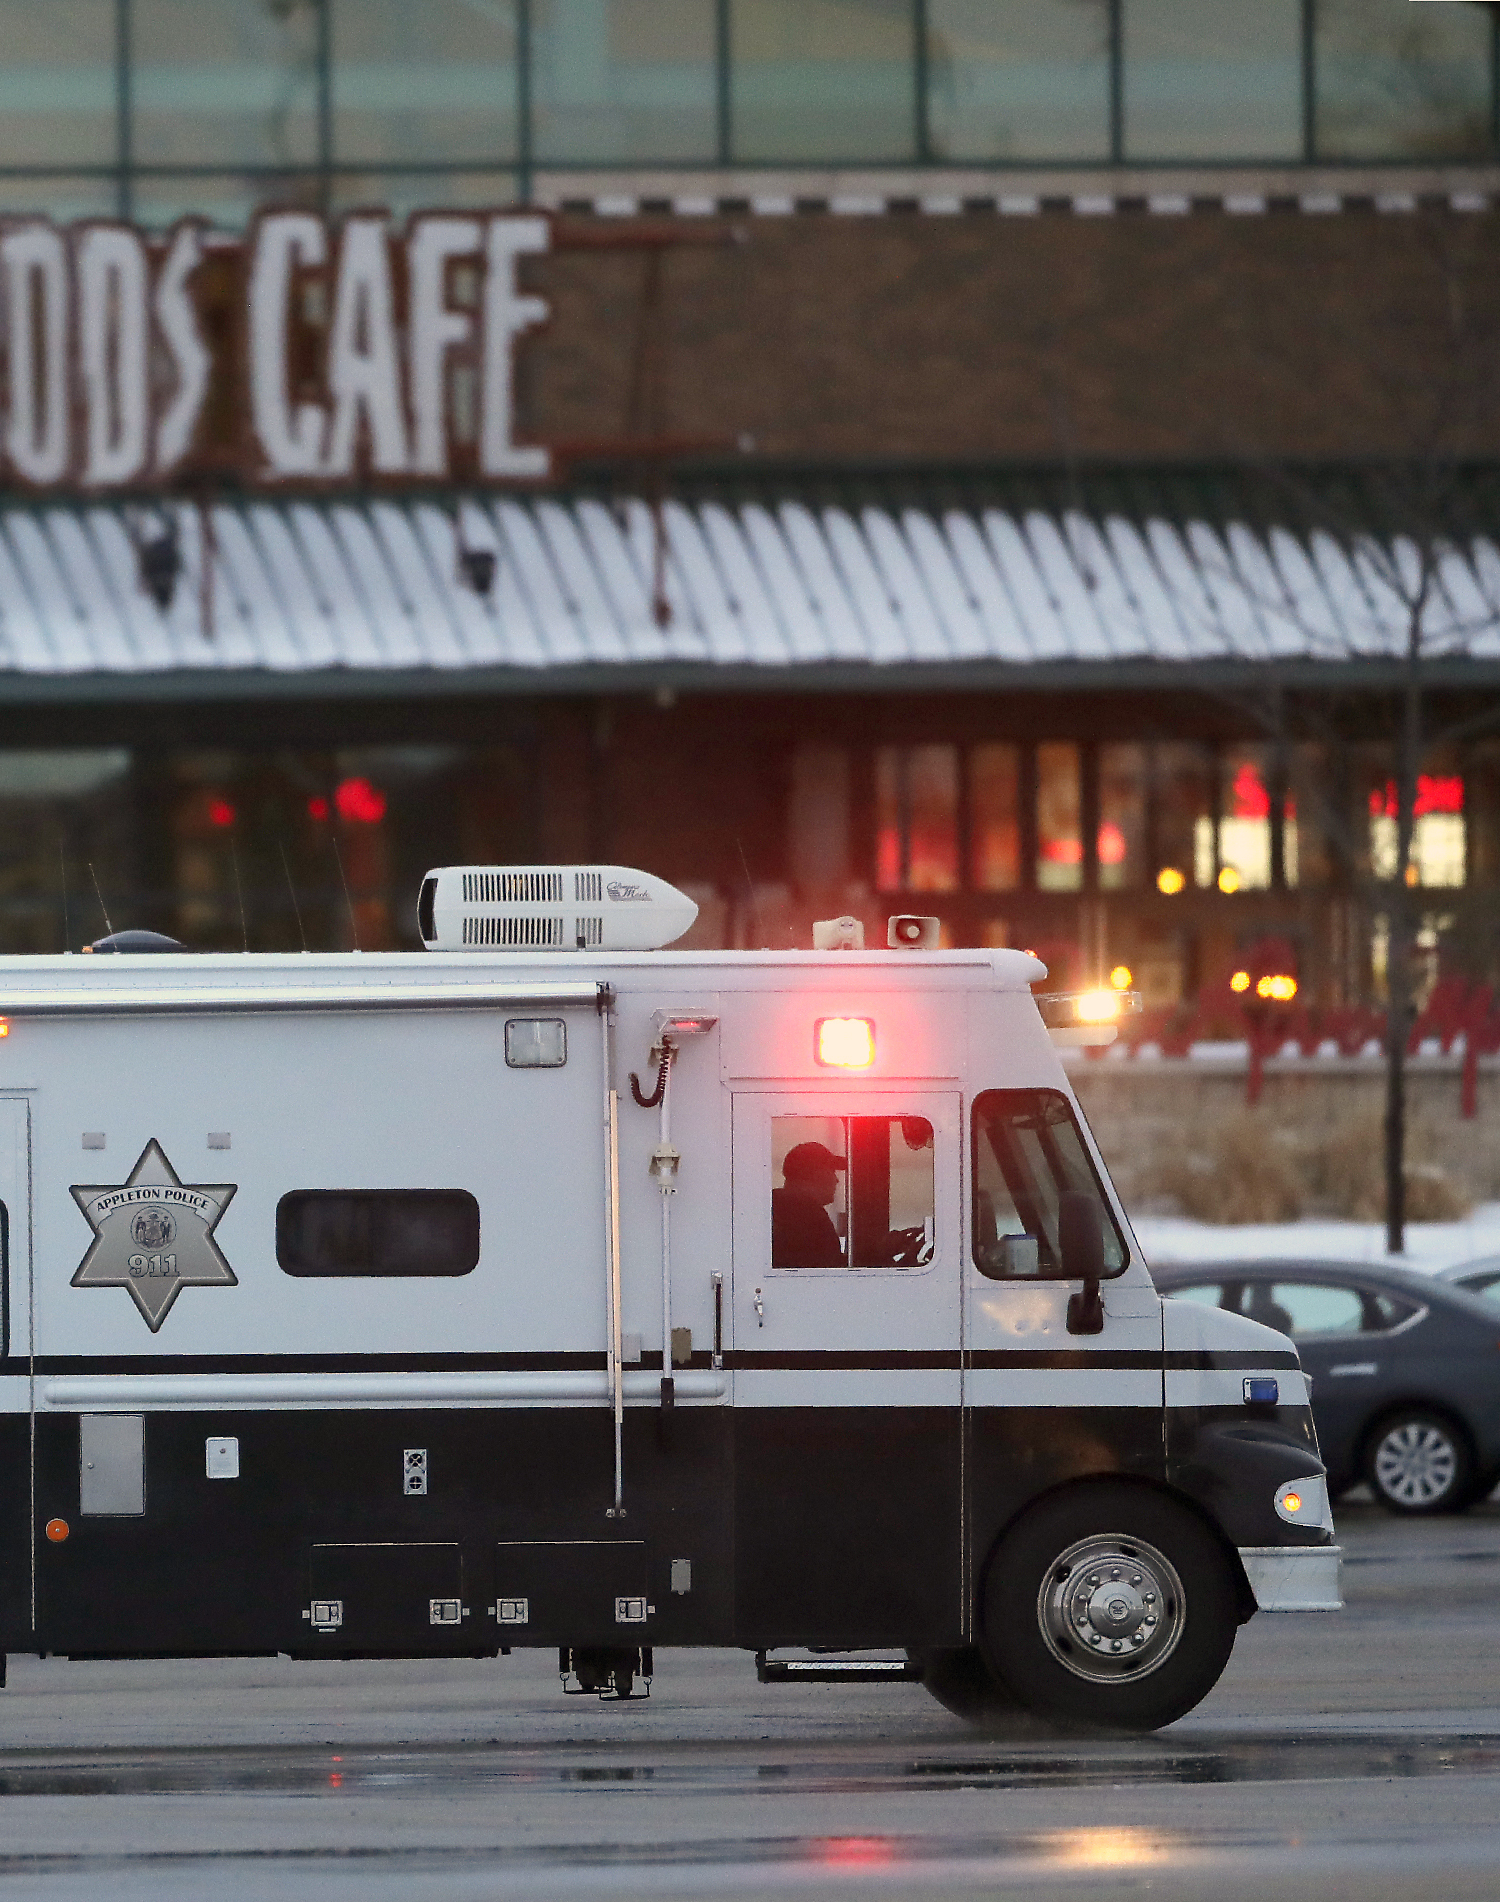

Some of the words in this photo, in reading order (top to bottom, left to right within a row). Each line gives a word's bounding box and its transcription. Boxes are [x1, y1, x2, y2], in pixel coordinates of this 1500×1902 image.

[250, 215, 550, 475] CAFE
[96, 1189, 160, 1212] APPLETON
[164, 1189, 209, 1210] POLICE
[128, 1254, 180, 1277] 911
